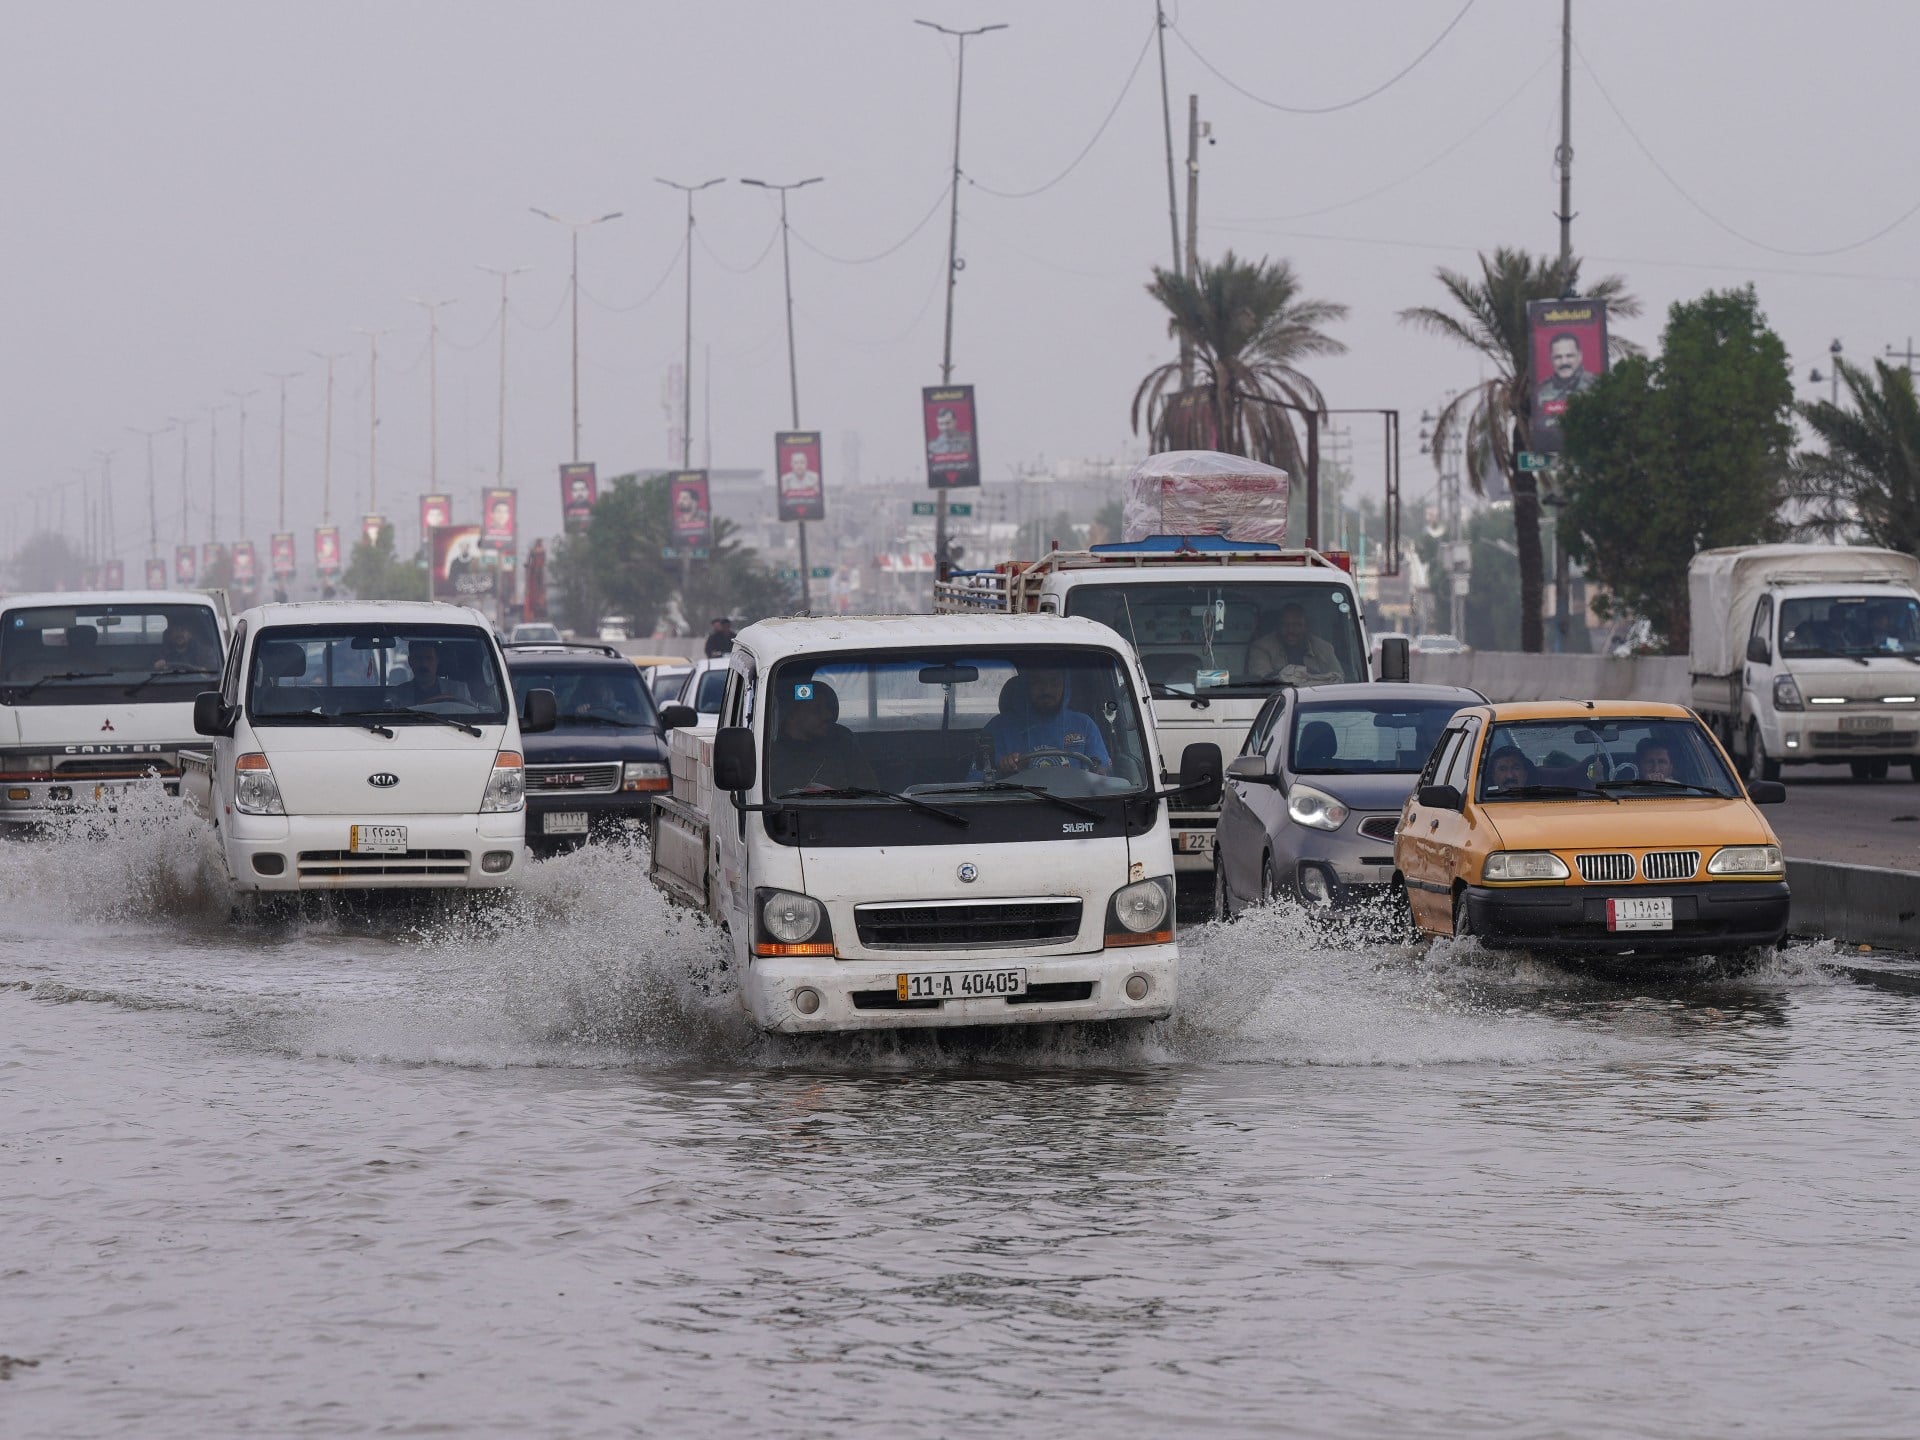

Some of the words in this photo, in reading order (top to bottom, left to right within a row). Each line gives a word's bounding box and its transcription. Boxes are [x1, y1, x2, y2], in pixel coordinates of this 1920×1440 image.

[65, 744, 161, 754] CANTER
[373, 775, 395, 785] KIA
[545, 774, 585, 784] GMC
[1062, 822, 1095, 833] SILENT
[961, 972, 1020, 995] 40405
